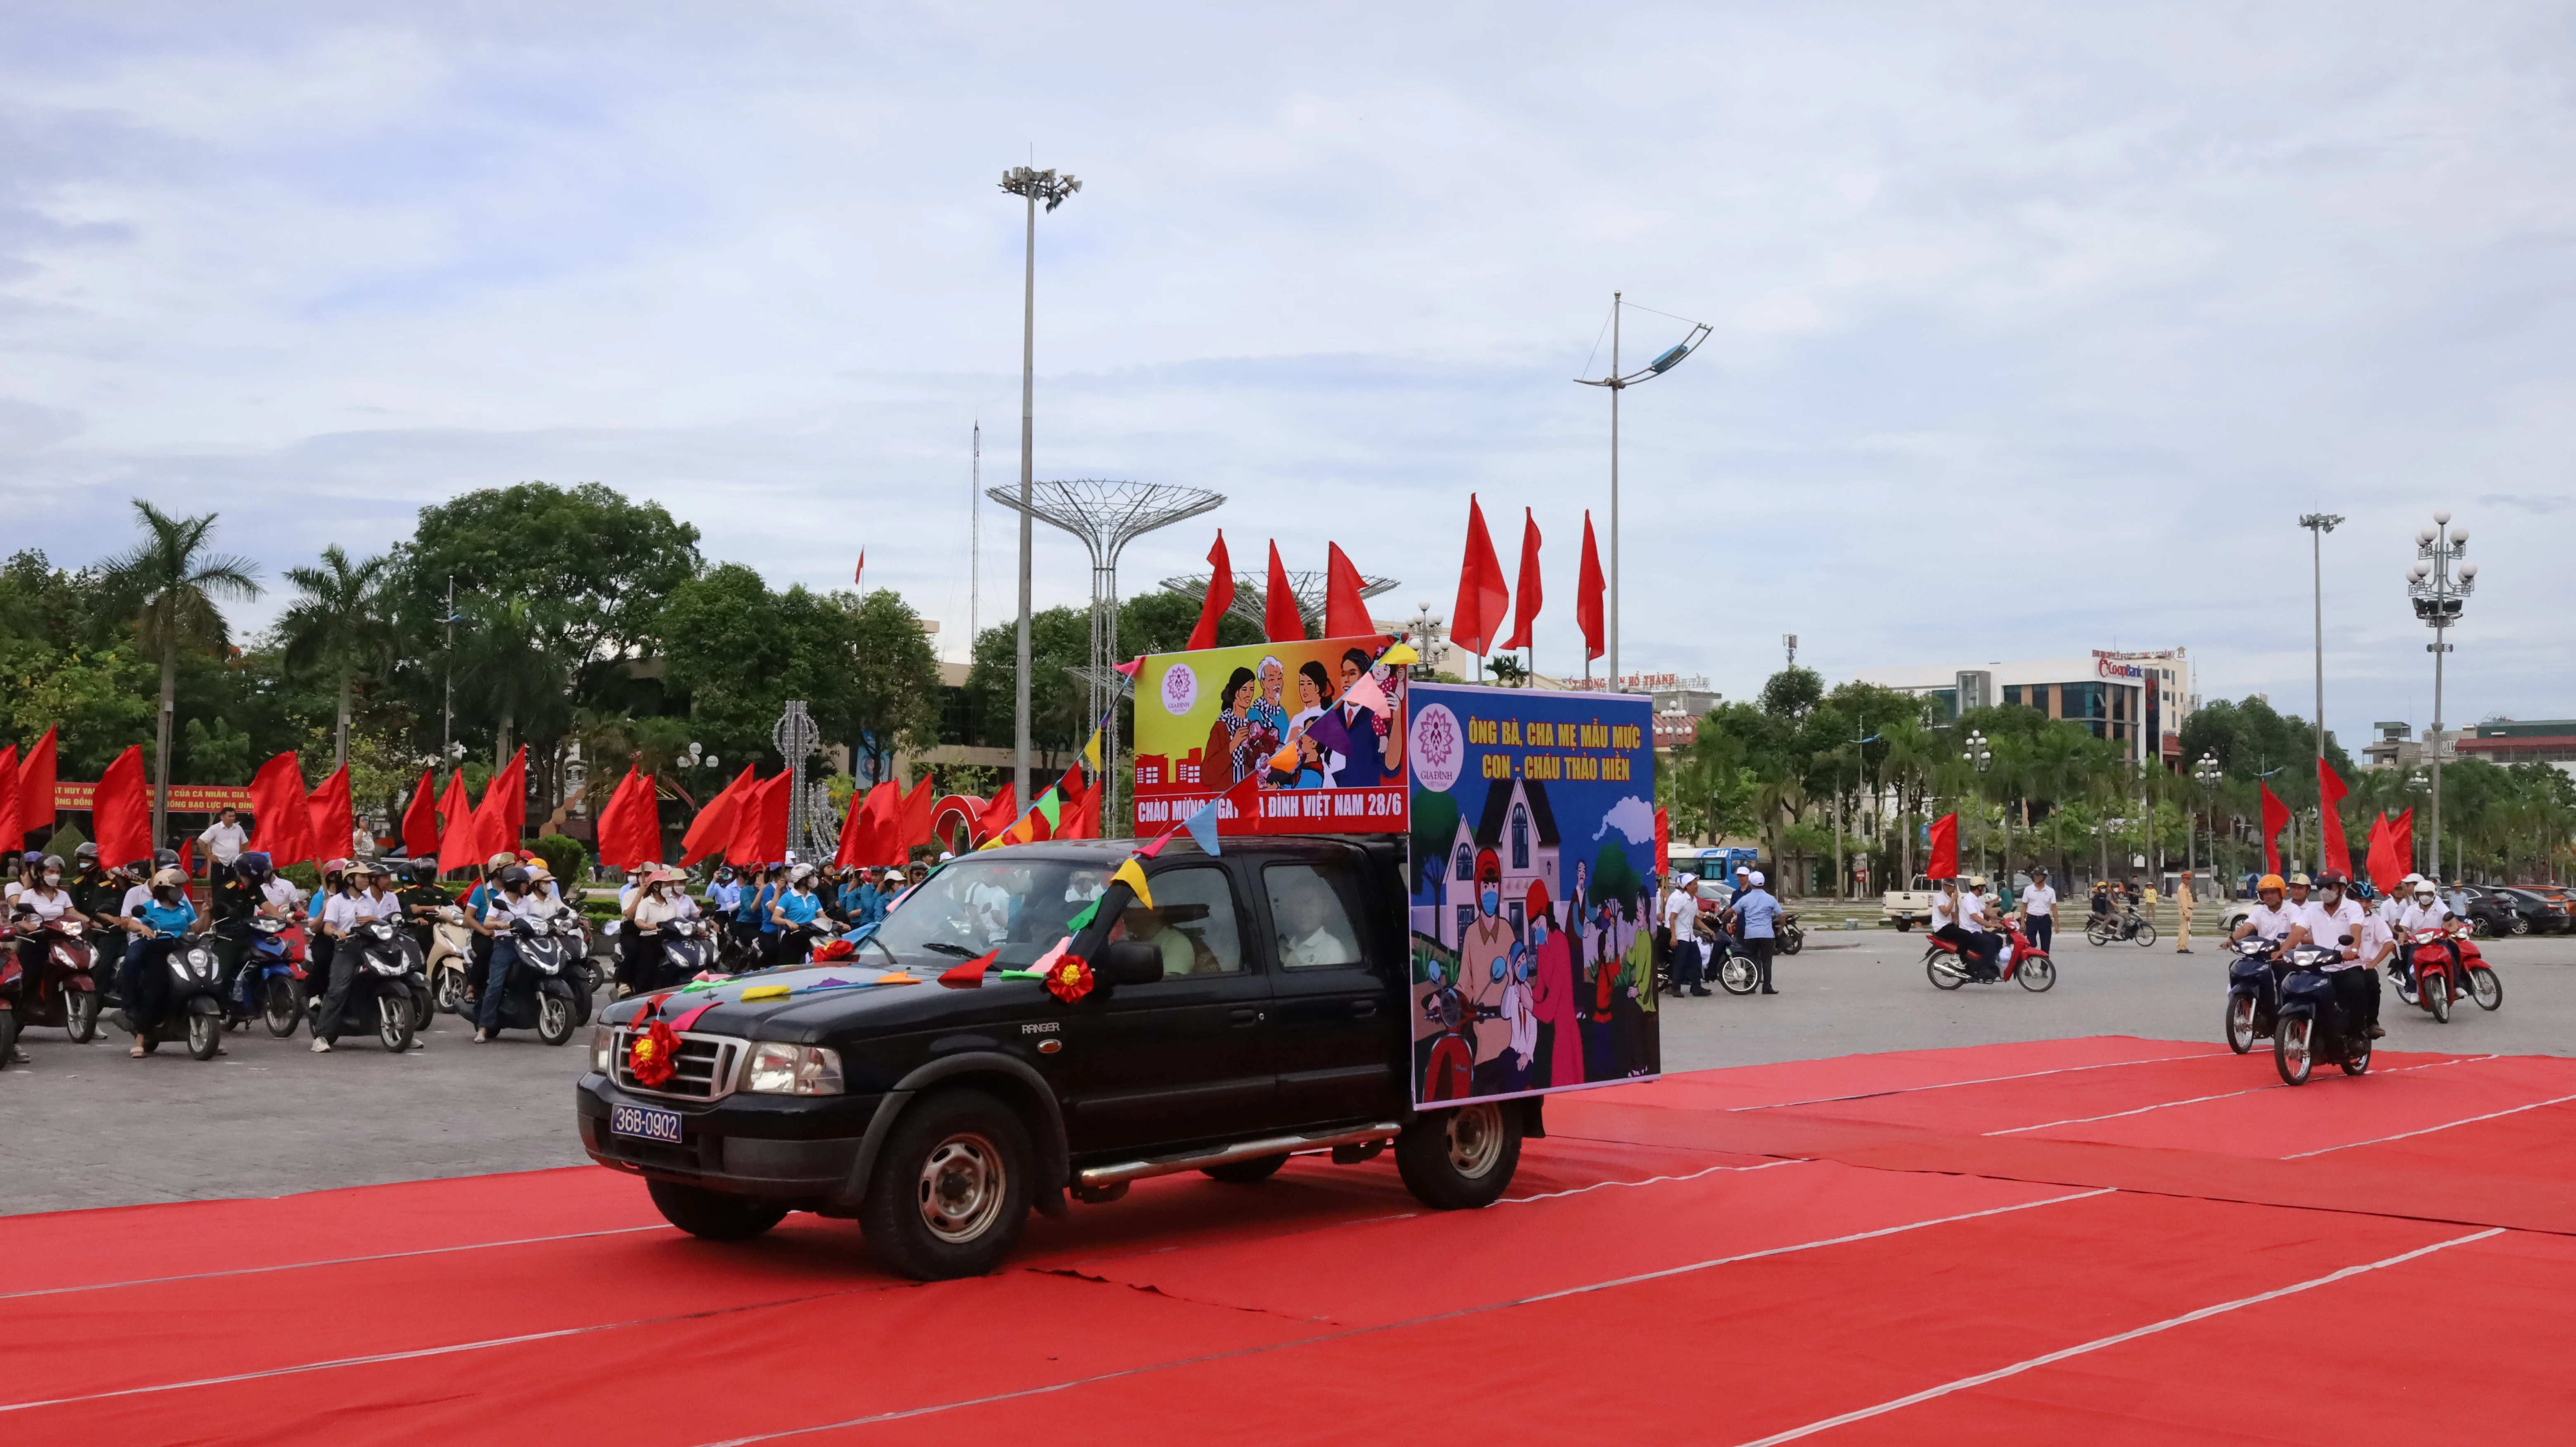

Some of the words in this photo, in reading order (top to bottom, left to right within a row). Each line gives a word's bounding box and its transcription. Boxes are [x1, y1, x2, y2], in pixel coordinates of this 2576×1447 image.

[1644, 672, 1675, 686] THÀNH
[1468, 715, 1497, 745] ÔNG
[1501, 717, 1523, 748] BÀ,
[1527, 722, 1554, 746] CHA
[1558, 724, 1577, 752] MẸ
[1580, 718, 1608, 748] MẪU
[1612, 723, 1641, 753] MỰC
[1482, 754, 1511, 779] CON
[1524, 752, 1560, 780] CHÁU
[1564, 751, 1598, 780] THẢO
[1601, 750, 1630, 780] HIỀN
[174, 788, 190, 797] CỦA
[192, 789, 203, 797] CÁ
[188, 801, 204, 809] BẠO
[206, 801, 221, 810] LỰC
[1138, 798, 1169, 822] CHÀO
[1268, 793, 1299, 818] ĐÌNH
[1302, 791, 1331, 821] VIỆT
[1335, 794, 1364, 816] NAM
[1368, 793, 1402, 816] 28/6
[1022, 1022, 1060, 1034] RANGER
[616, 1108, 677, 1139] 36B-0902
